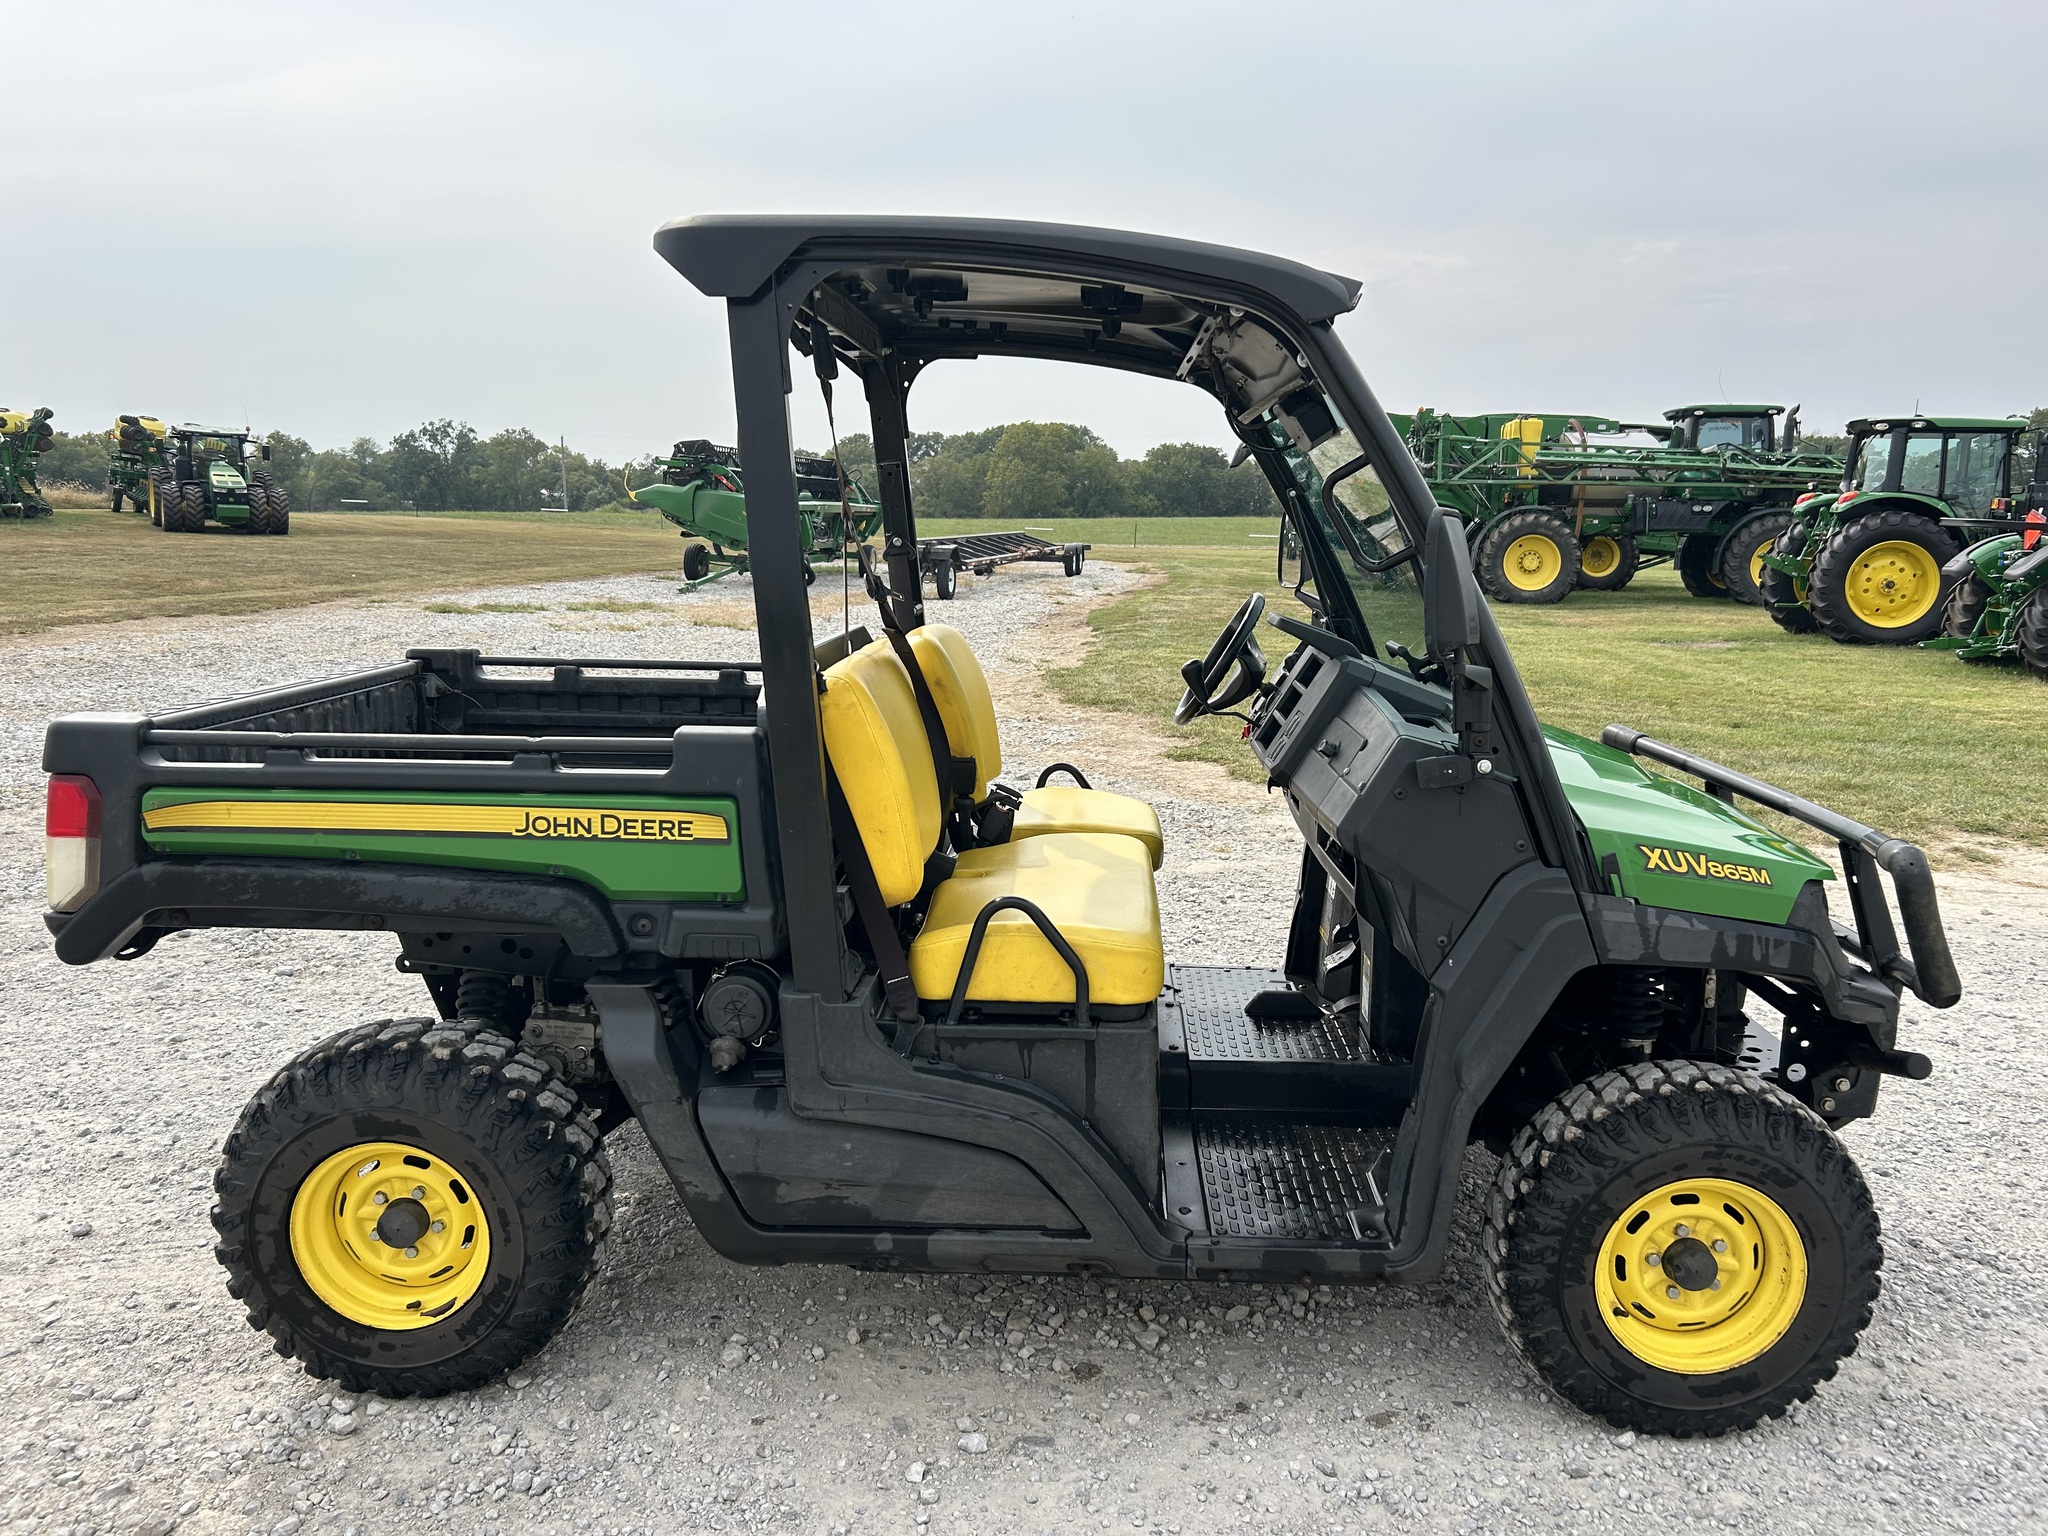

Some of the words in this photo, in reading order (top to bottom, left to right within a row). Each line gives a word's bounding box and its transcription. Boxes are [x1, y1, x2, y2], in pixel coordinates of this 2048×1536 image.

[514, 811, 592, 835] JOHN
[600, 813, 694, 838] DEERE
[1637, 845, 1773, 887] XUV865M
